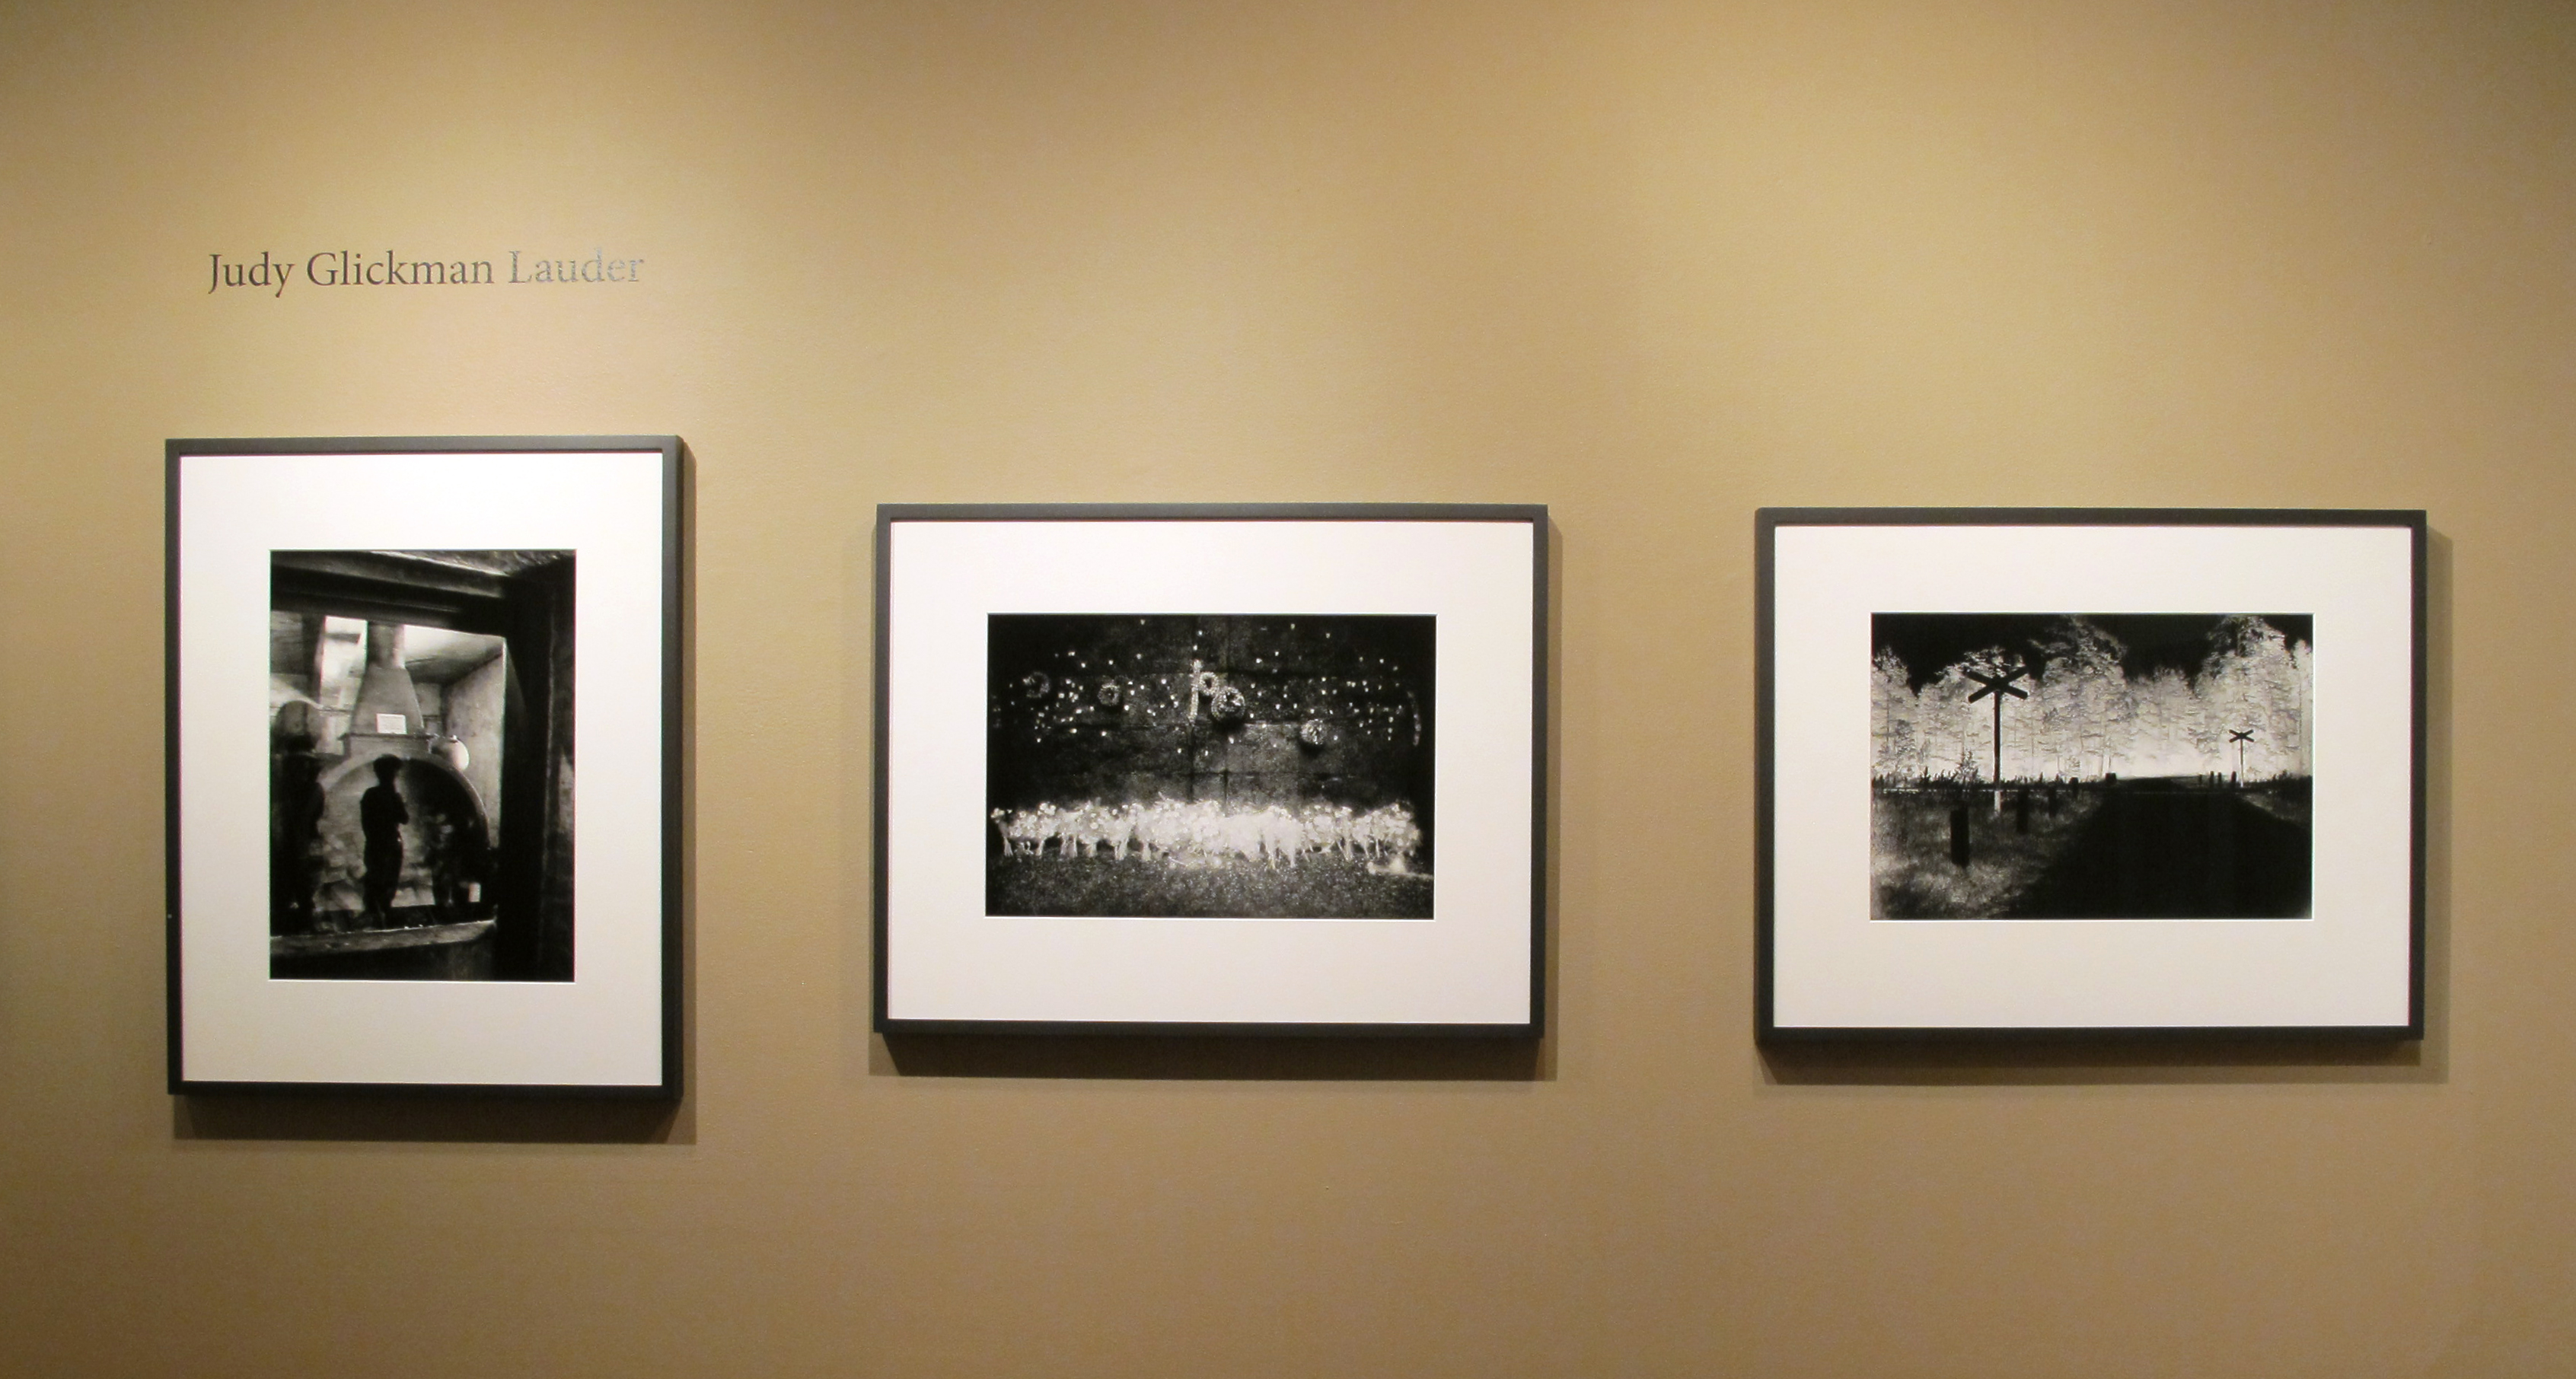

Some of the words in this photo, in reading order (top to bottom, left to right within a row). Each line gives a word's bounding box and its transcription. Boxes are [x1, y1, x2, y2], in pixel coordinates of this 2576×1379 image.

[208, 252, 295, 298] Judy
[307, 250, 495, 286] Glickman
[508, 247, 644, 284] Lauder
